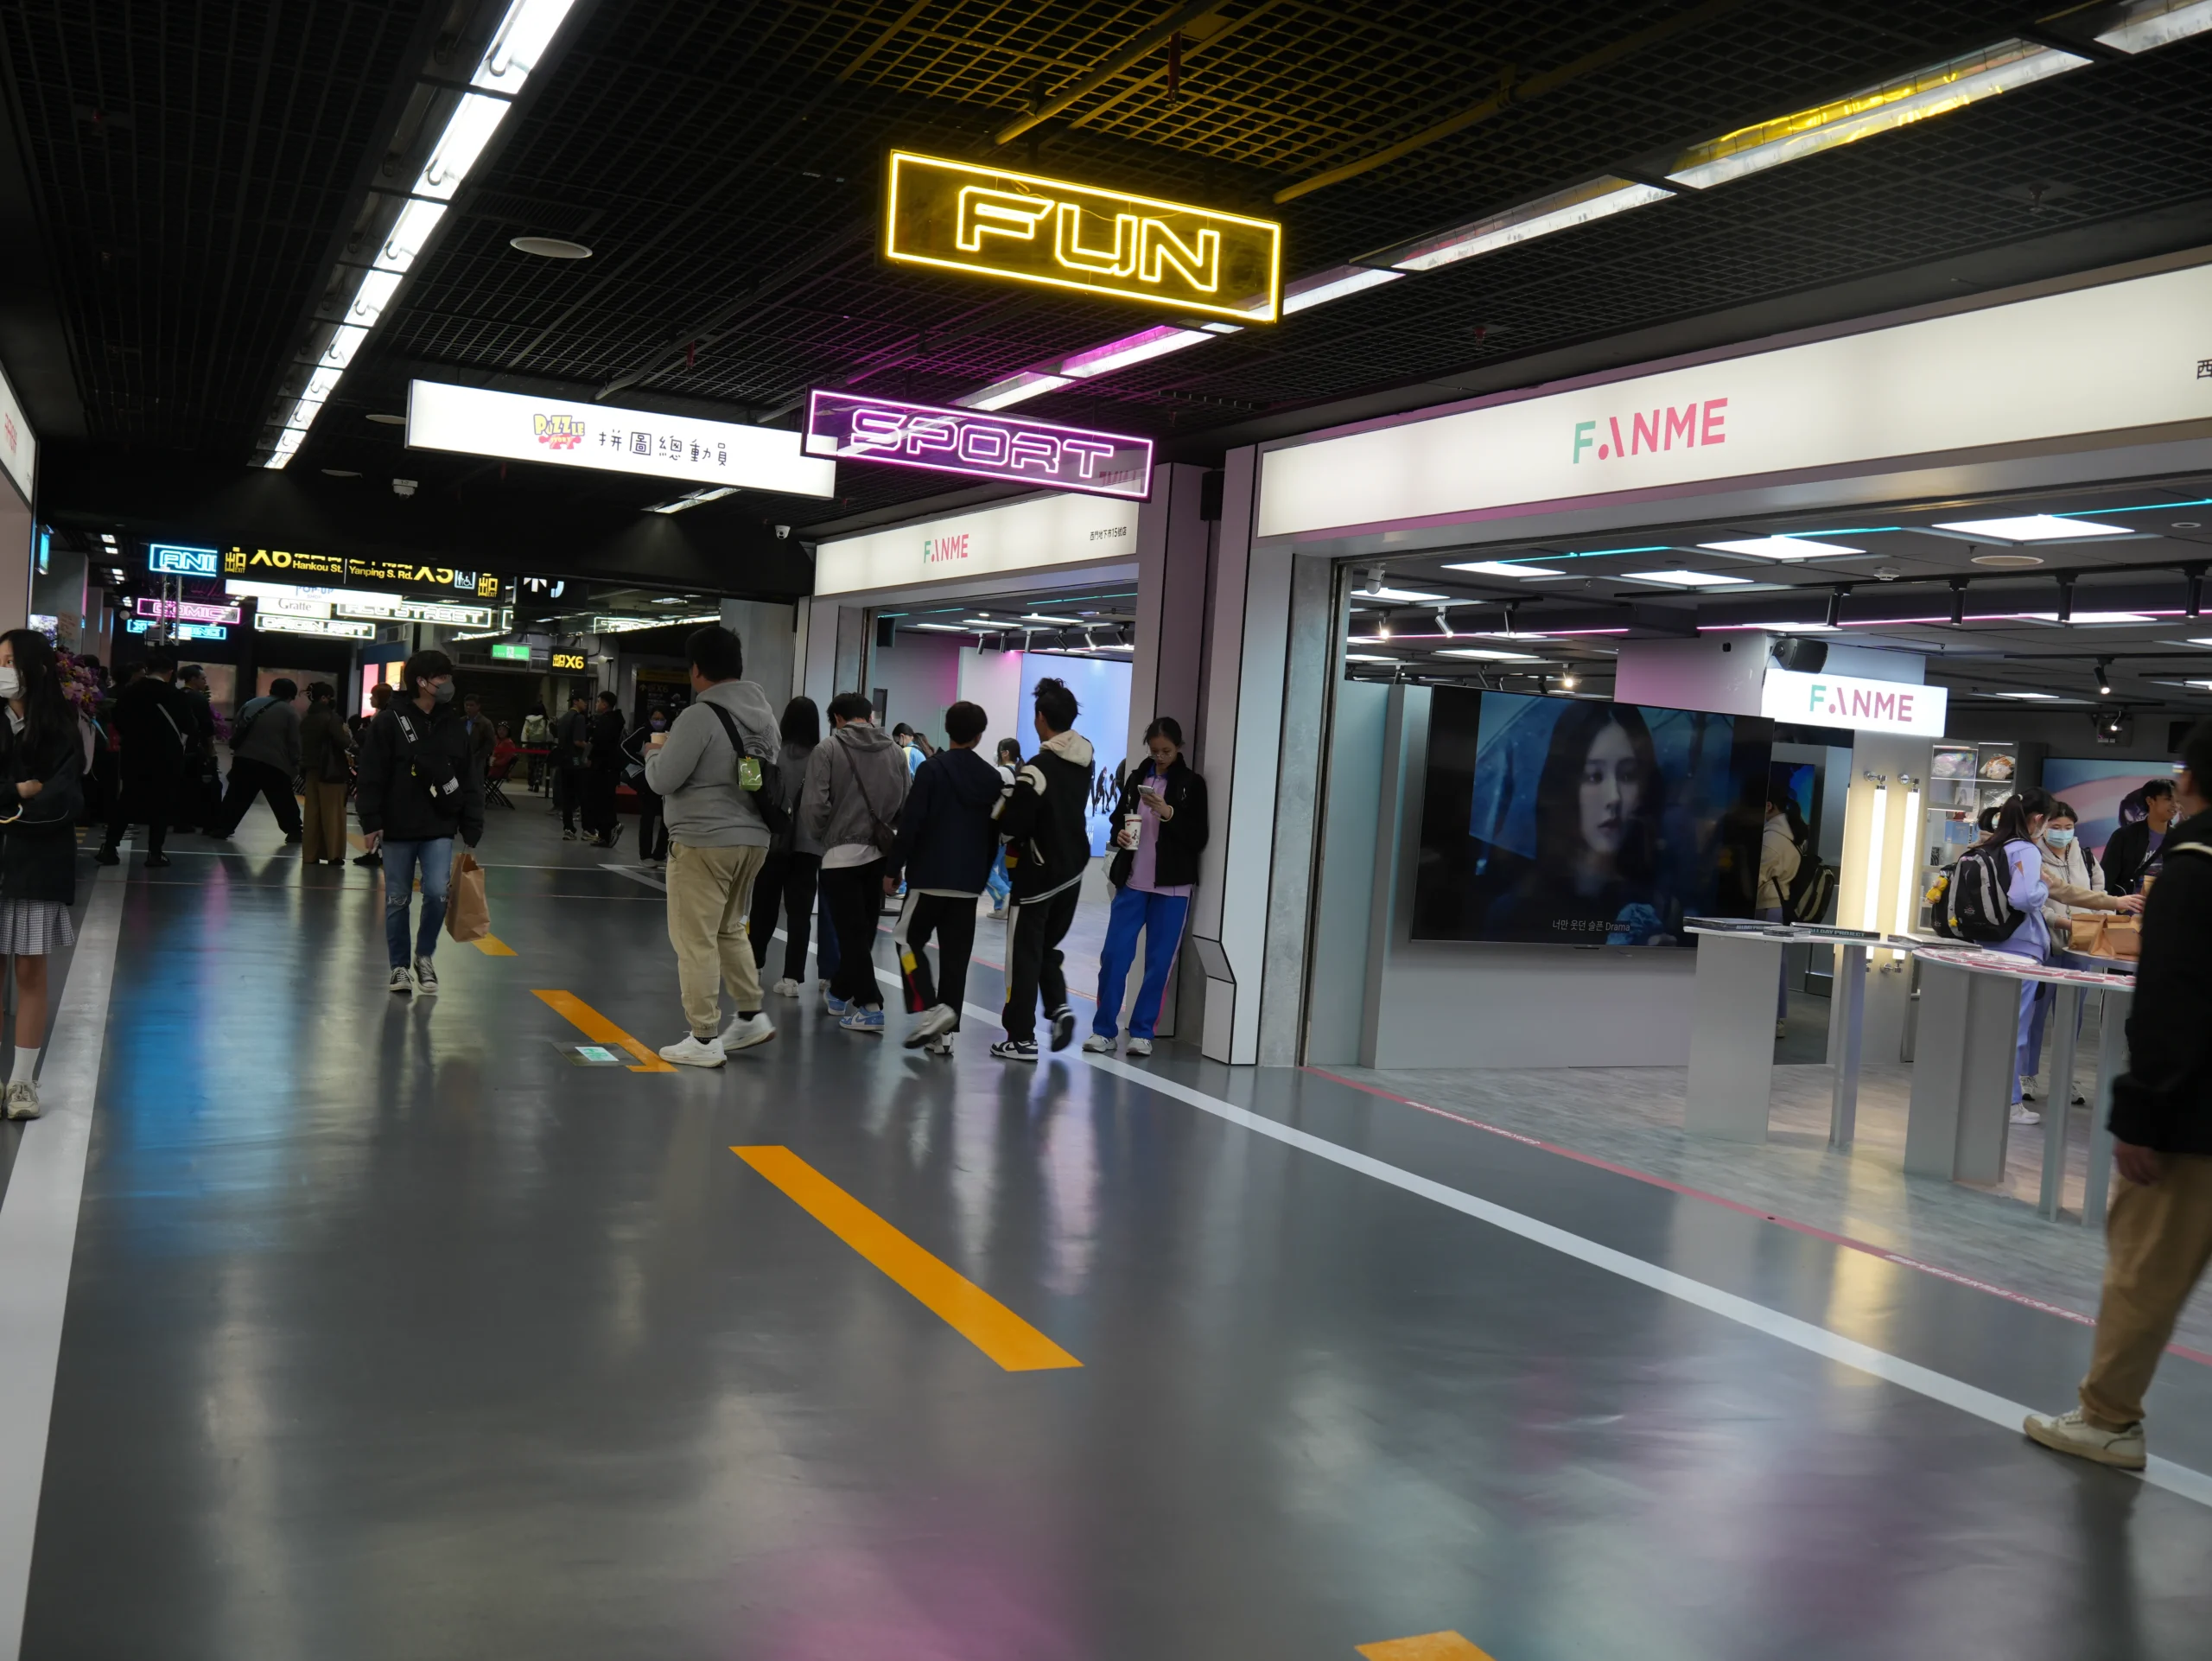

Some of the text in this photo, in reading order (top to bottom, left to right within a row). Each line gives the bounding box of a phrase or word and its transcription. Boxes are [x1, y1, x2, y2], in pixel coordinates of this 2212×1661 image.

[956, 185, 1221, 293] FUN
[533, 414, 586, 436] PUZZLE
[1573, 397, 1728, 465] FANME
[598, 429, 728, 467] 拼圖總動員
[851, 409, 1114, 479] SPORT
[924, 533, 969, 563] FANME
[292, 560, 328, 572] Hankou
[330, 563, 344, 574] St.
[349, 565, 413, 581] Yanping S. Rd.
[394, 605, 484, 624] STREET
[564, 655, 585, 670] X6
[1809, 684, 1914, 722] FANME
[1552, 919, 1630, 932] 너만 웃던 슬픈 Drama
